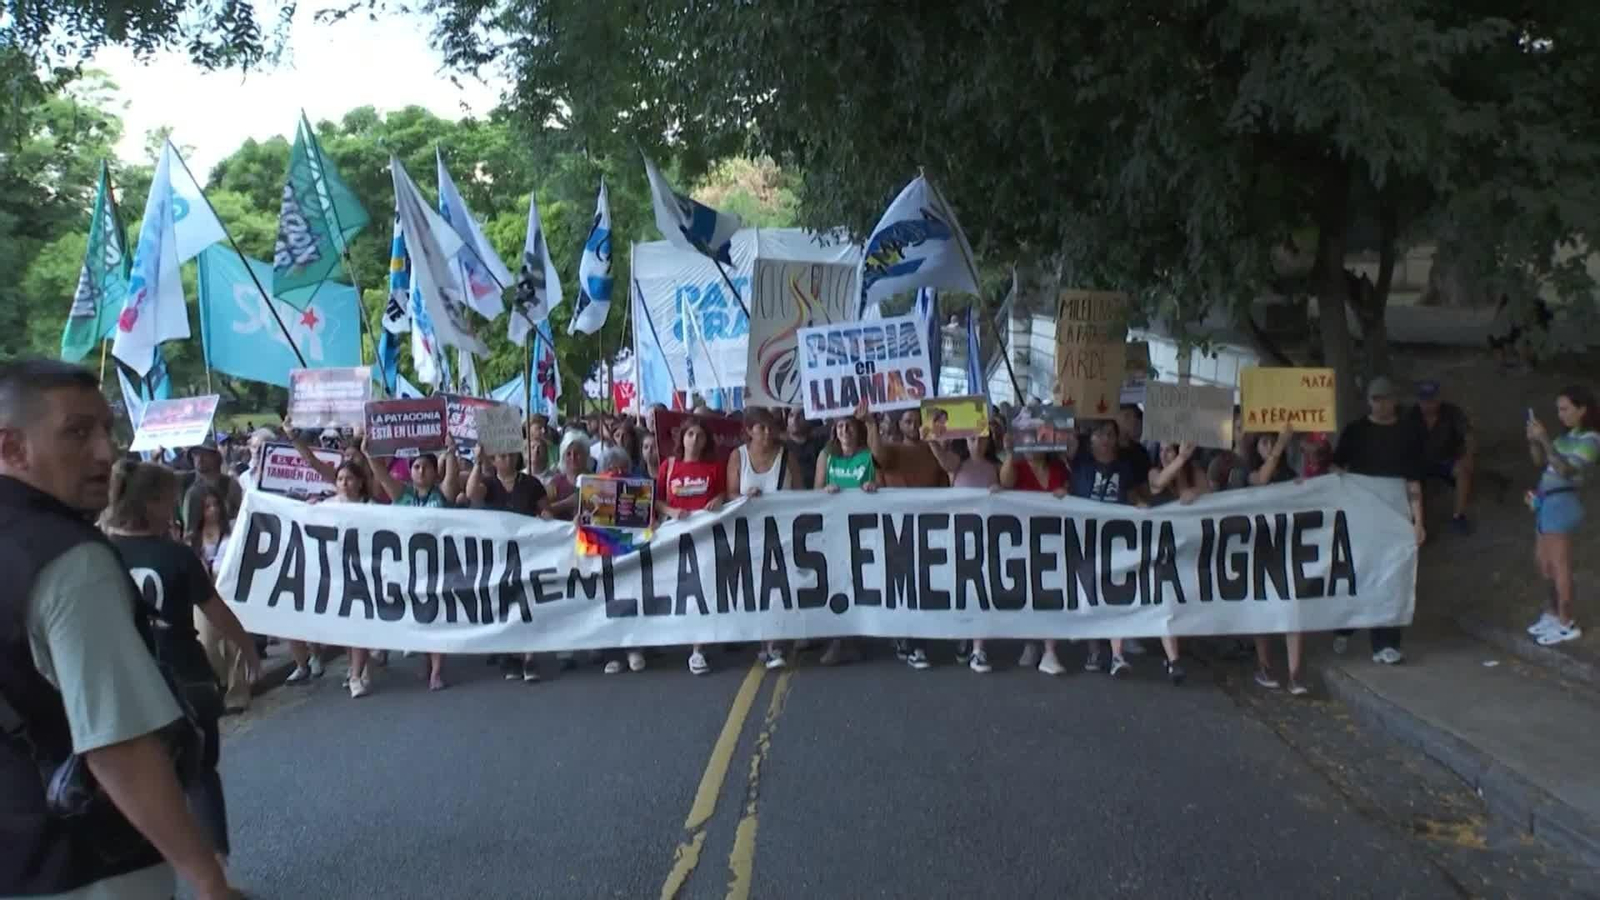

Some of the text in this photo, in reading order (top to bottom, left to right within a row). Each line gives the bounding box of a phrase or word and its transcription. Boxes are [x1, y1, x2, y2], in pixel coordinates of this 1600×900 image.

[676, 277, 750, 313] PAT
[806, 322, 922, 369] PATRIA
[855, 360, 876, 375] en
[809, 367, 927, 412] LLAMAS
[1300, 374, 1335, 388] MATA
[370, 410, 442, 425] LA PATAGONIA
[394, 425, 406, 439] EN
[407, 423, 442, 438] LLAMAS
[234, 511, 533, 625] PATAGONIA
[529, 566, 600, 604] EN
[848, 512, 1187, 611] EMERGENCIA
[1198, 509, 1358, 602] IGNEA
